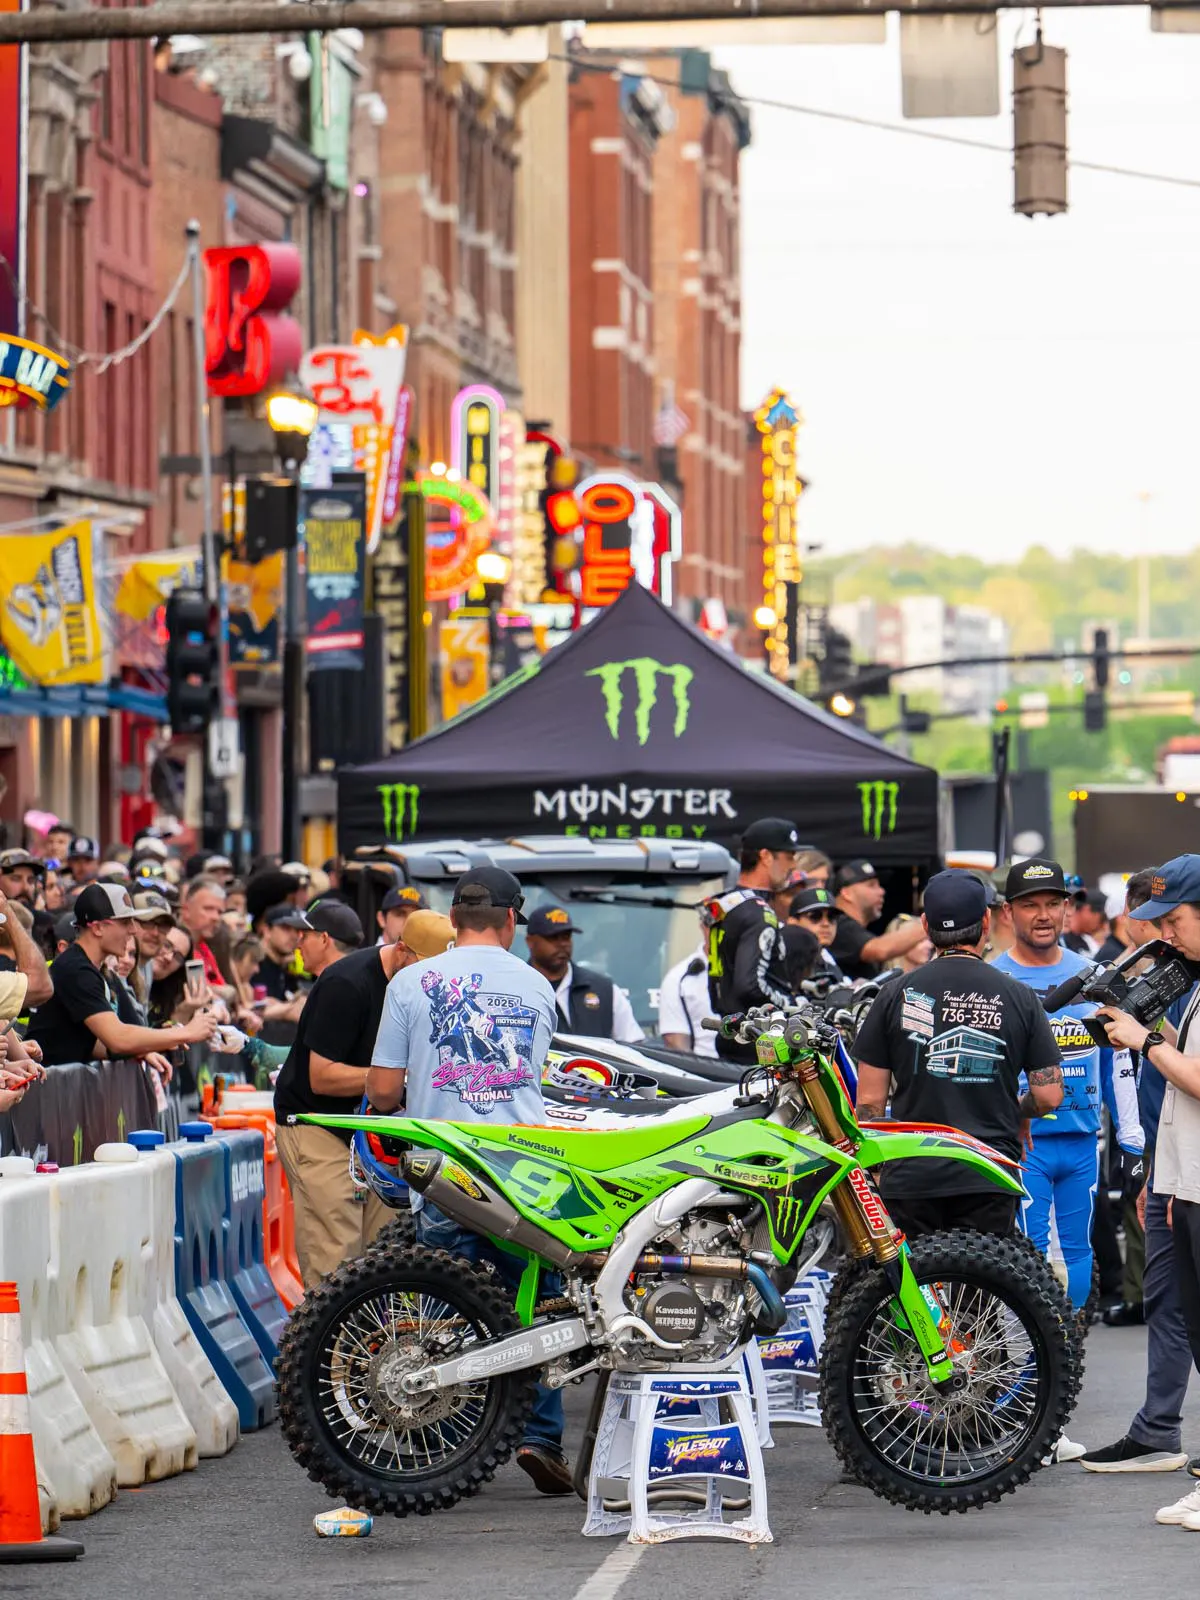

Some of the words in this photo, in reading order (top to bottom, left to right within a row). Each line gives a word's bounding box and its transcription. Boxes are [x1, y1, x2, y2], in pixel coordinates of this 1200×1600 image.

[203, 246, 274, 397] B
[533, 783, 737, 821] MONSTER
[564, 824, 707, 838] ENERGY
[487, 998, 515, 1007] 2025
[942, 1008, 1002, 1026] 736-3376
[1061, 1066, 1086, 1076] AMAHA
[462, 1090, 512, 1102] NATIONAL
[508, 1133, 565, 1157] Kawasaki
[714, 1163, 779, 1186] Kawasaki
[849, 1168, 886, 1230] SHOWA
[655, 1306, 697, 1315] Kawasaki
[668, 1437, 731, 1458] HOLESHOT
